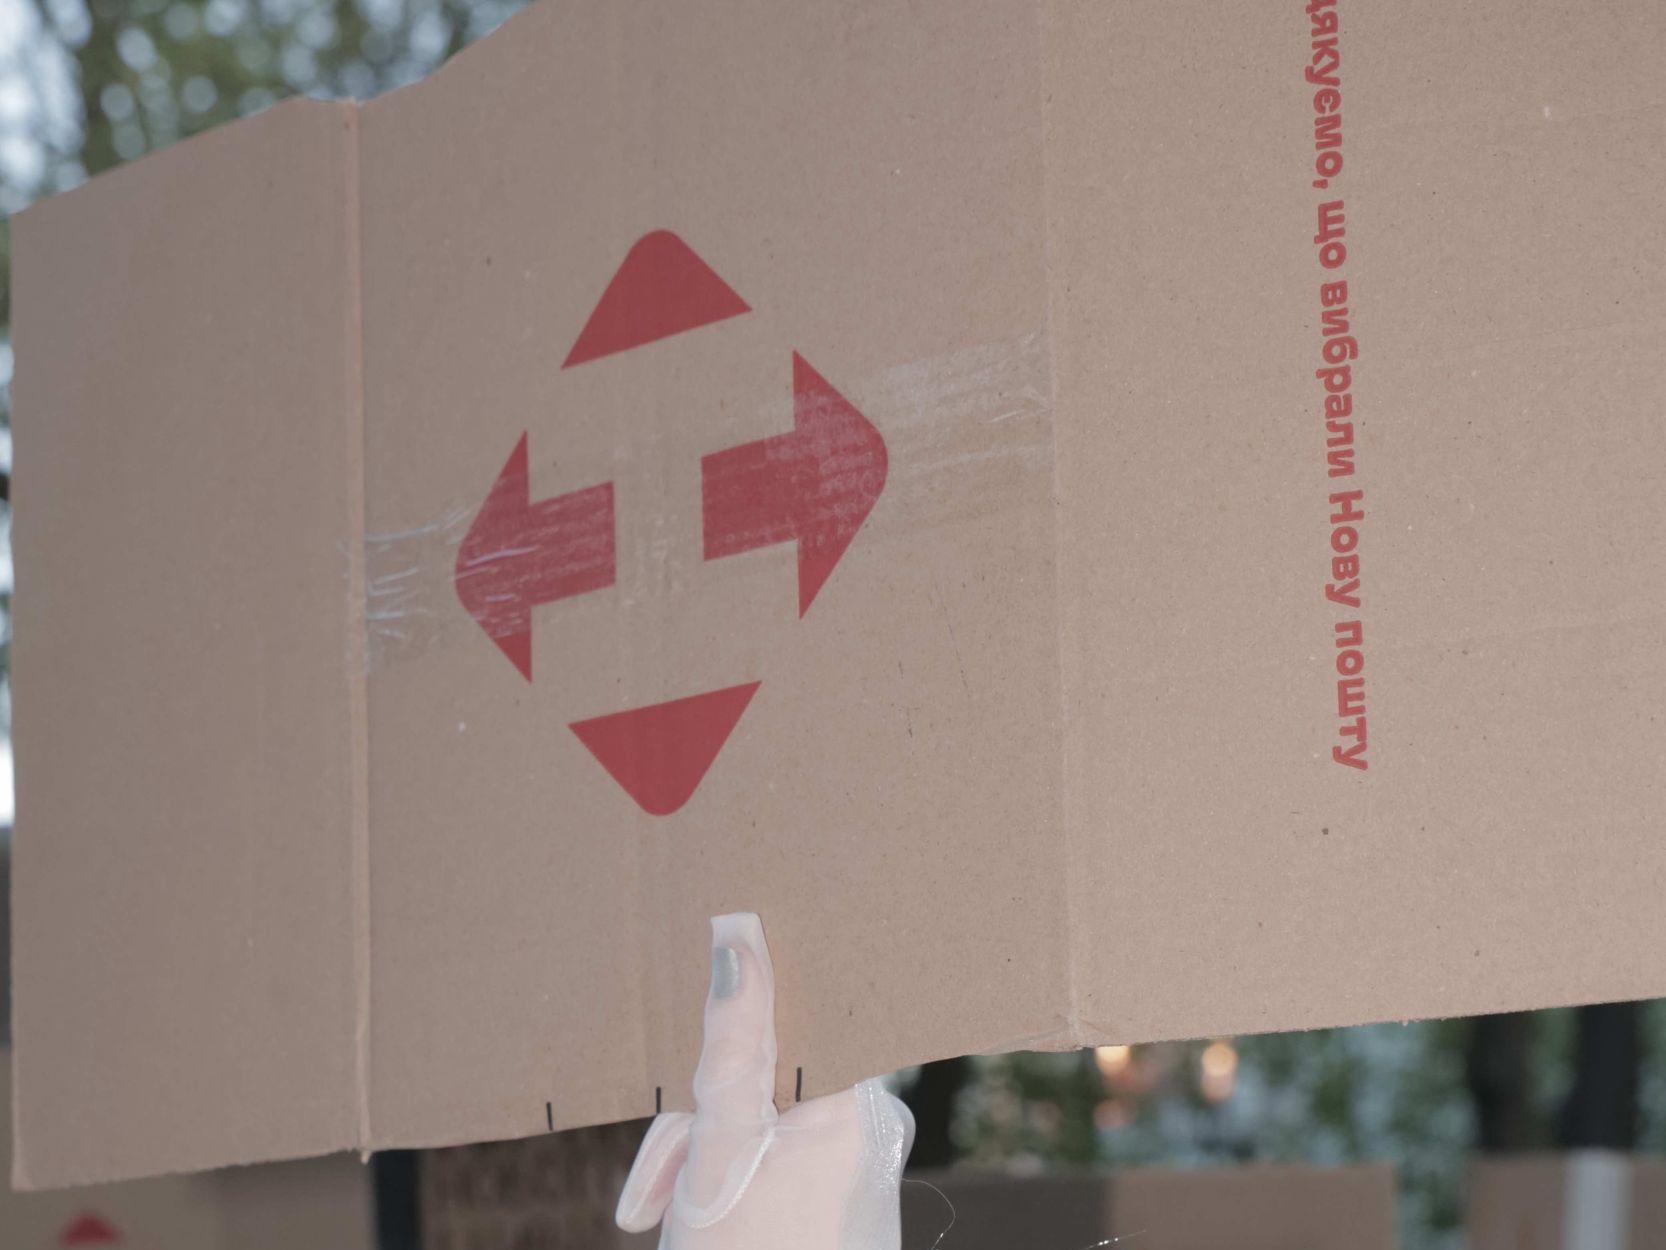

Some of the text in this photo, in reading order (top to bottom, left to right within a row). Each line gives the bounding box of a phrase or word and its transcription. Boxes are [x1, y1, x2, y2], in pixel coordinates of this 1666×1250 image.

[1313, 199, 1348, 270] що
[1315, 280, 1359, 479] вибрали
[1324, 489, 1365, 609] Нову
[1332, 619, 1369, 771] пошту
